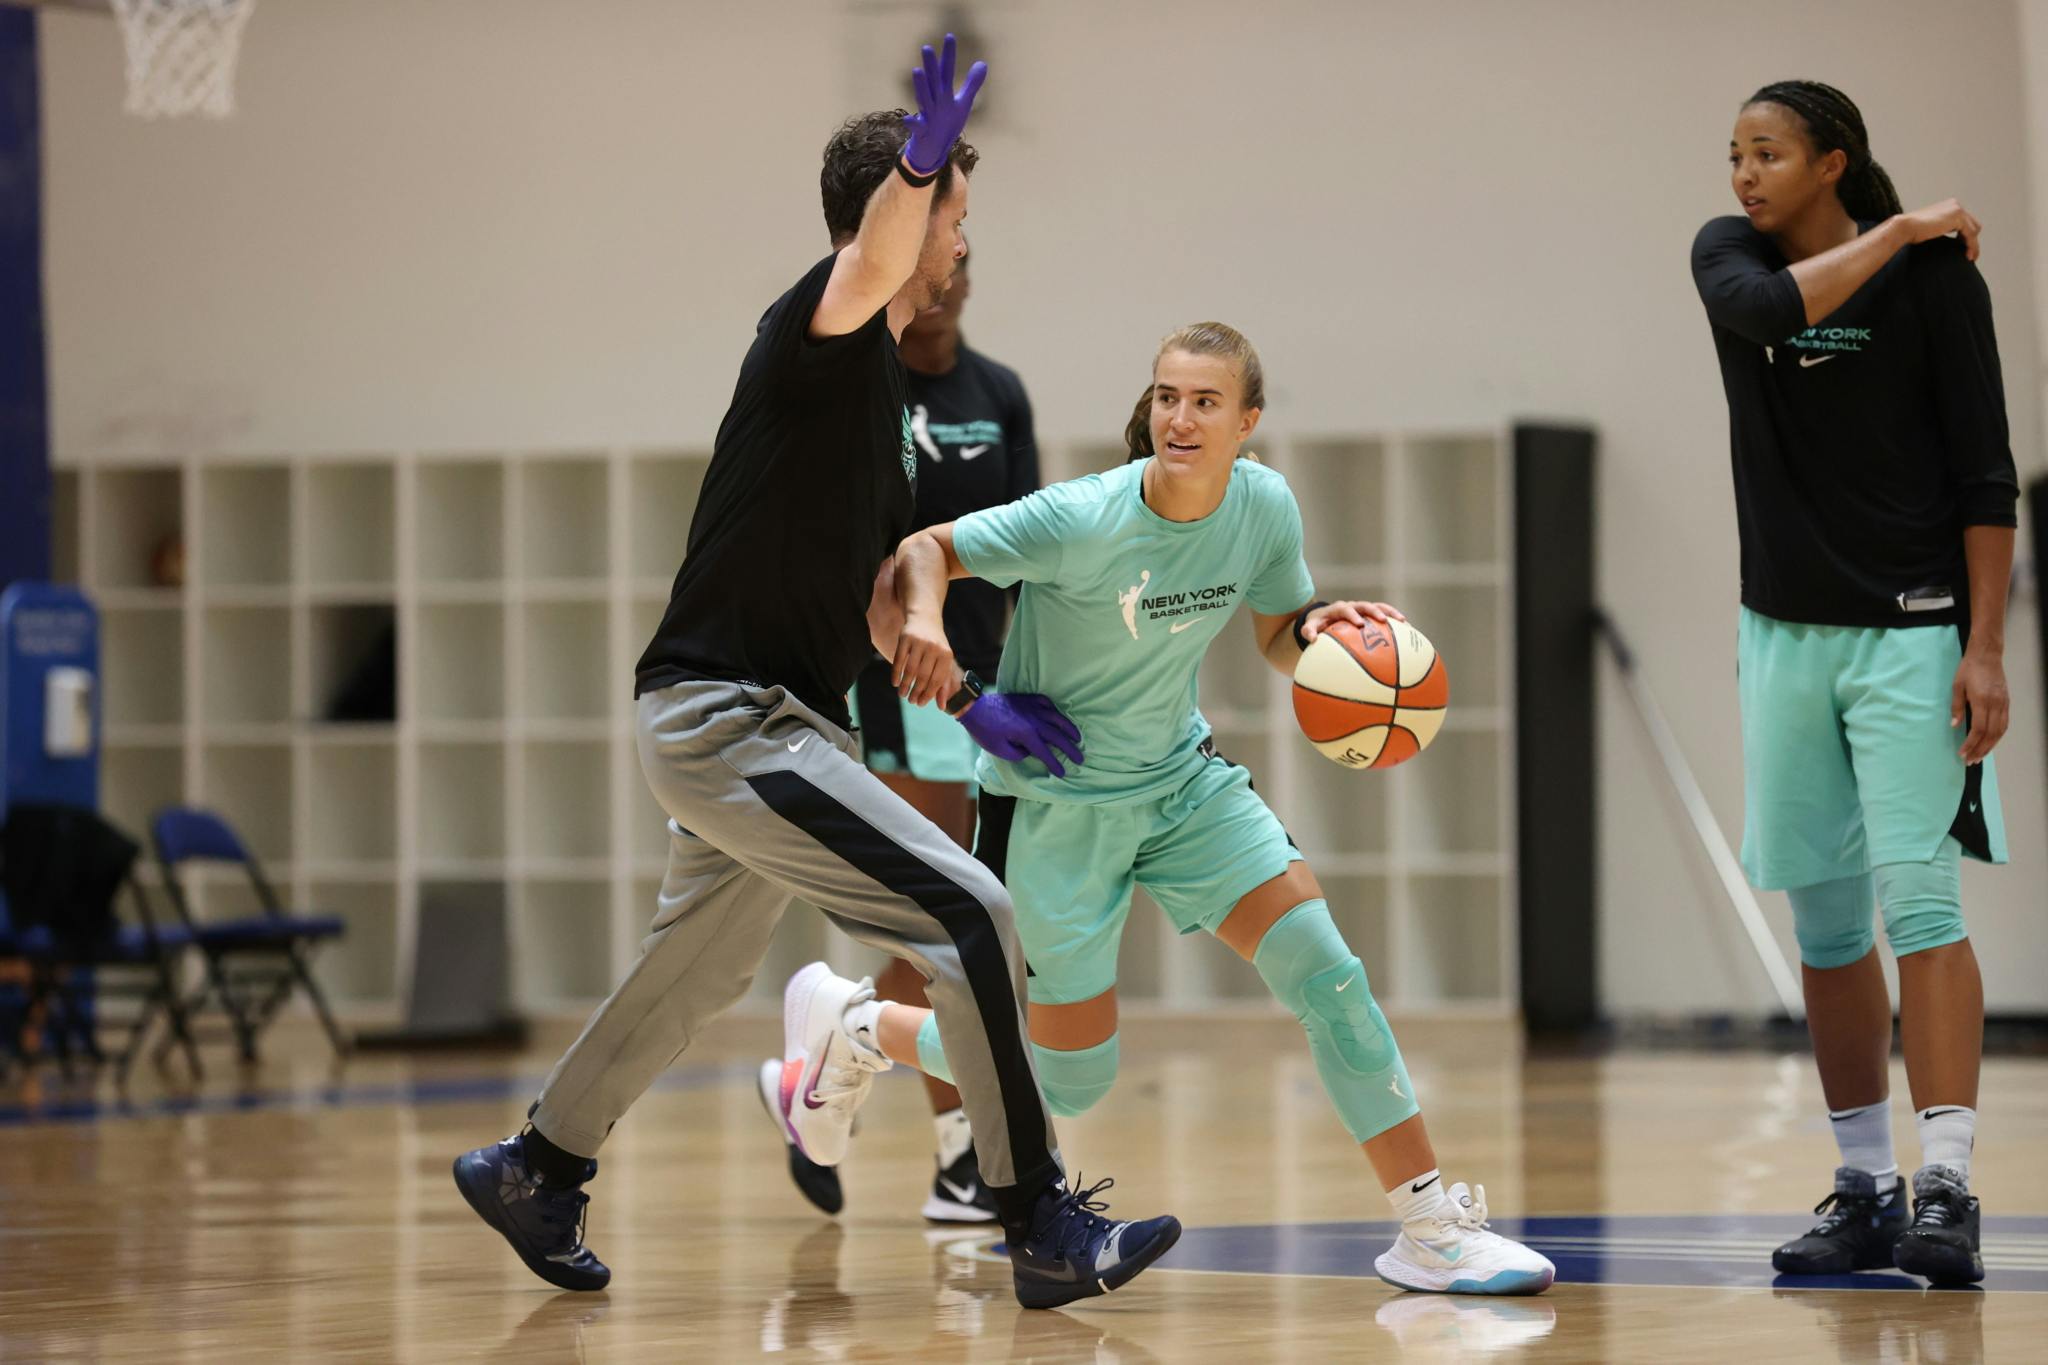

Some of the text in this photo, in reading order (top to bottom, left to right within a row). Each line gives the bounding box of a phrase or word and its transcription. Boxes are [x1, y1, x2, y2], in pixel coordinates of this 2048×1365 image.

[1819, 328, 1871, 341] YORK
[1142, 582, 1237, 610] NEW YORK
[1150, 600, 1229, 620] BASKETBALL
